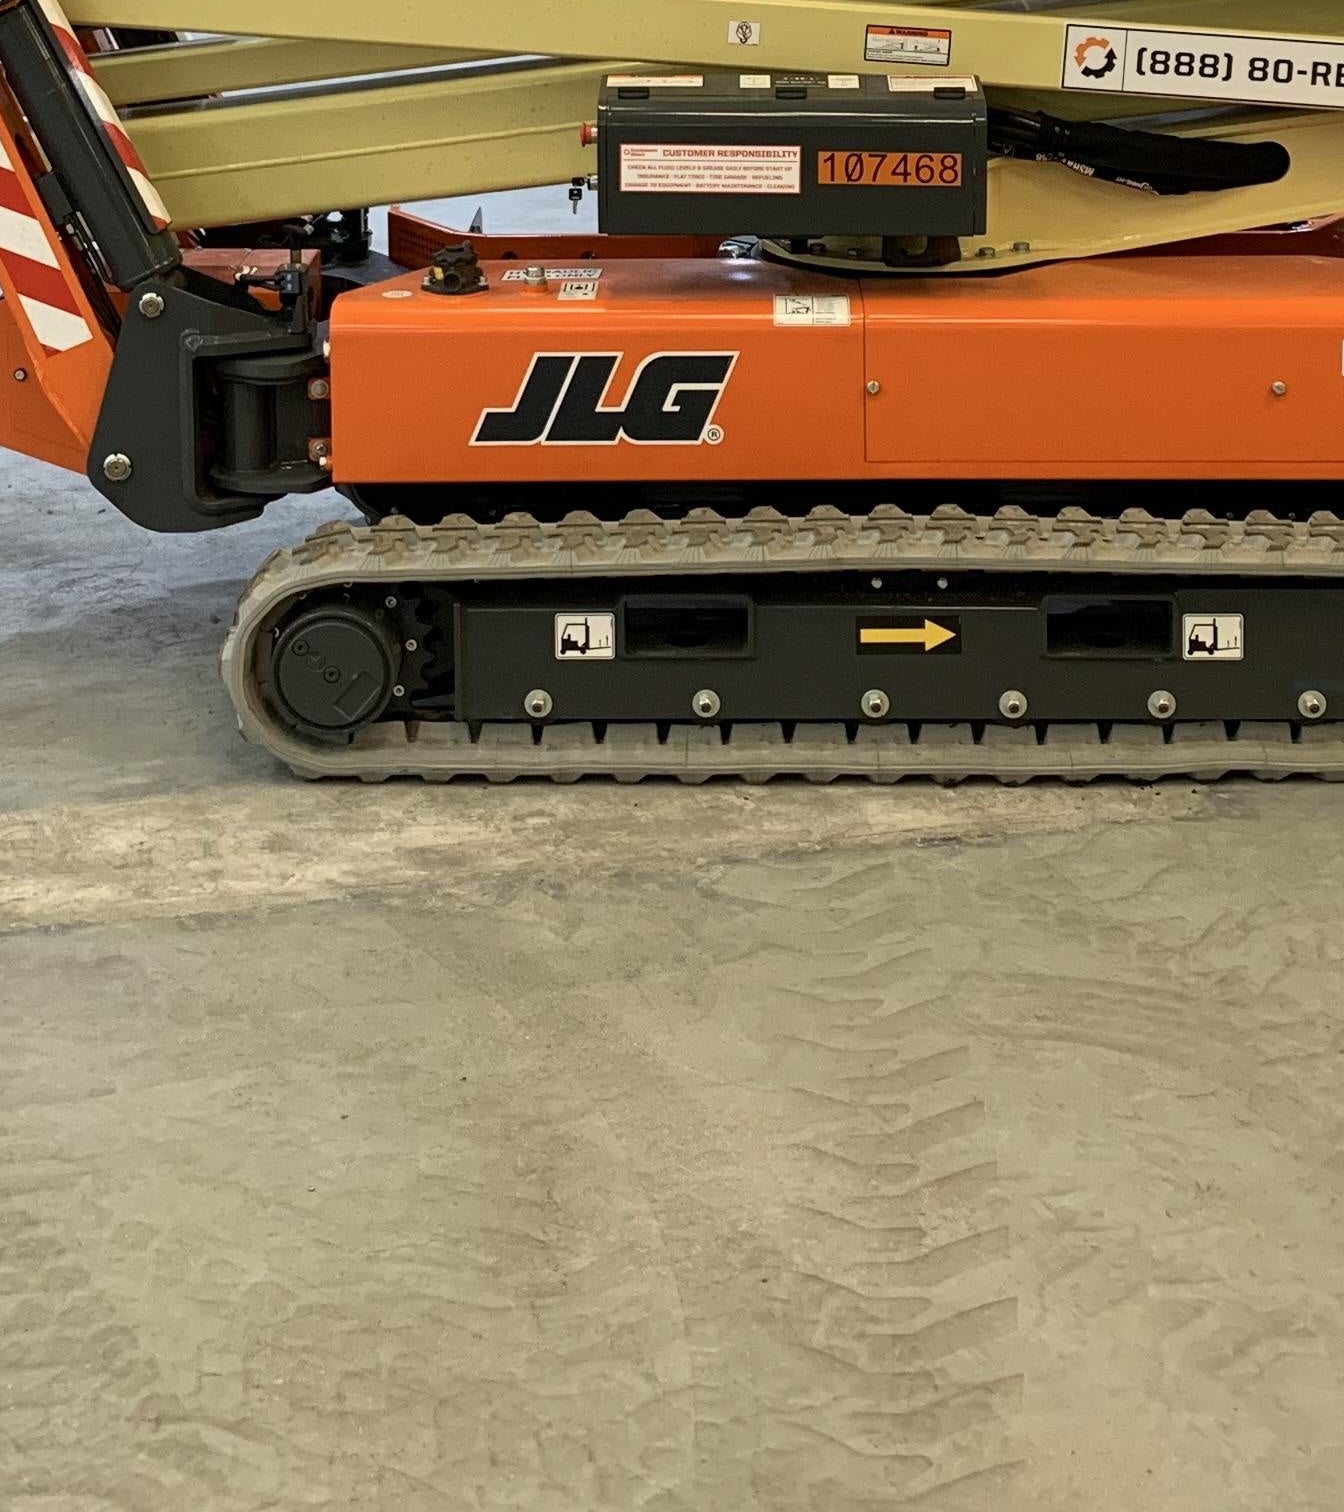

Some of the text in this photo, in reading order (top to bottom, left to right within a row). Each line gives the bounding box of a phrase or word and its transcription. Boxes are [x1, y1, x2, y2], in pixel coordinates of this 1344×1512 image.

[1136, 47, 1234, 82] (888)
[662, 149, 715, 158] CUSTOMER
[717, 150, 798, 159] RESPONSIBILITY
[822, 152, 959, 184] 107468
[471, 352, 740, 444] JLG
